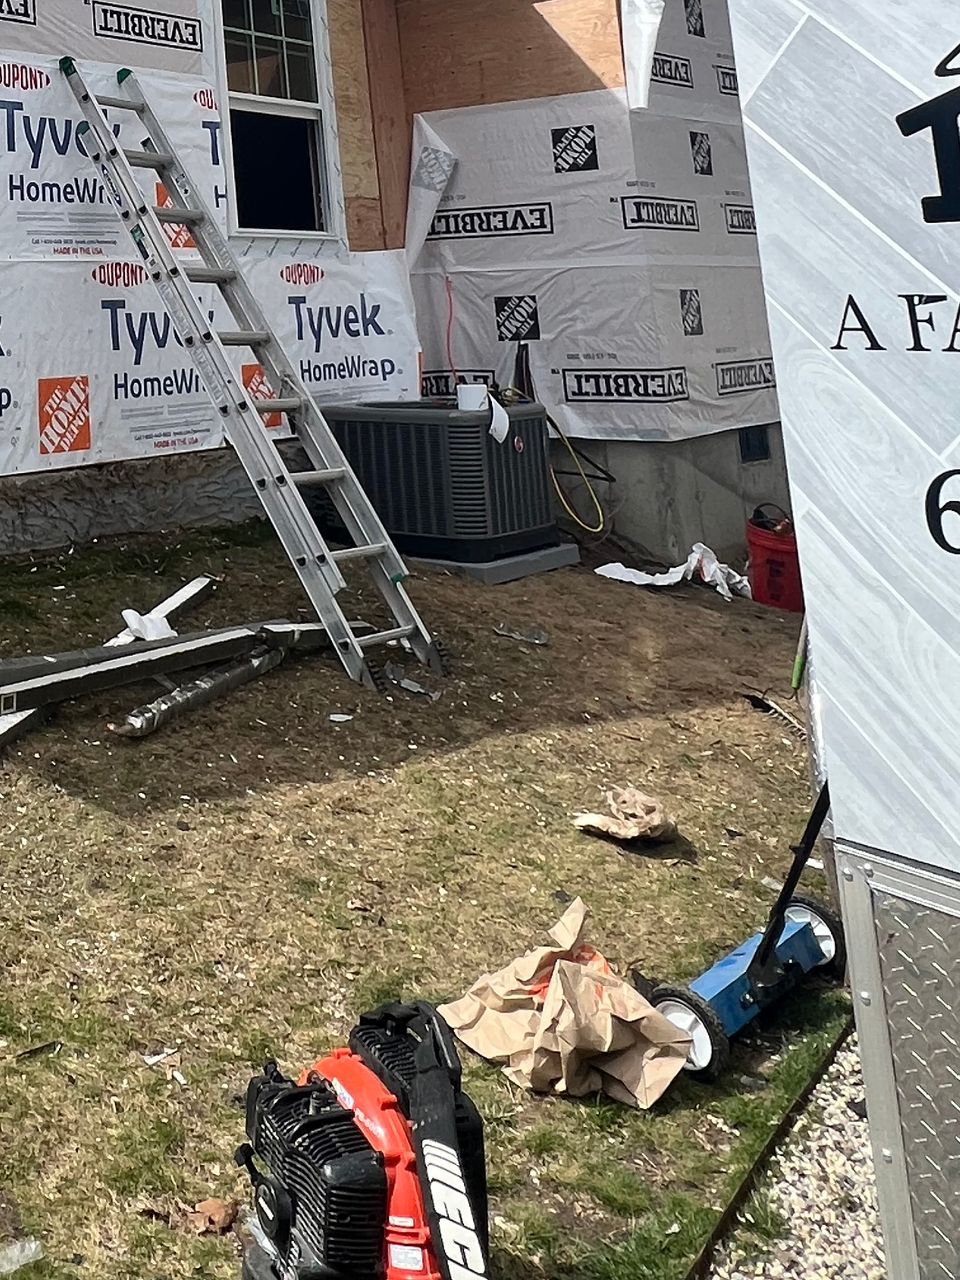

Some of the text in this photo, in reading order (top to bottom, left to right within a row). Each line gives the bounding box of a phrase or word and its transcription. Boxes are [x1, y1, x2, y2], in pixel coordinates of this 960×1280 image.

[99, 8, 200, 46] EVERBILT
[555, 126, 595, 173] HOME
[8, 174, 113, 204] HomeWr
[630, 201, 697, 226] EVERBILT
[99, 262, 145, 288] DUPONT
[289, 263, 320, 287] DUPONT
[101, 297, 214, 365] Tyv
[288, 293, 386, 353] Tyvek
[500, 297, 537, 340] HOME
[830, 293, 887, 352] A
[114, 369, 207, 401] HomeWr
[300, 355, 396, 382] HomeWrap
[572, 373, 687, 399] EVERBILT
[40, 375, 89, 453] HOME
[60, 401, 90, 452] DEPOT
